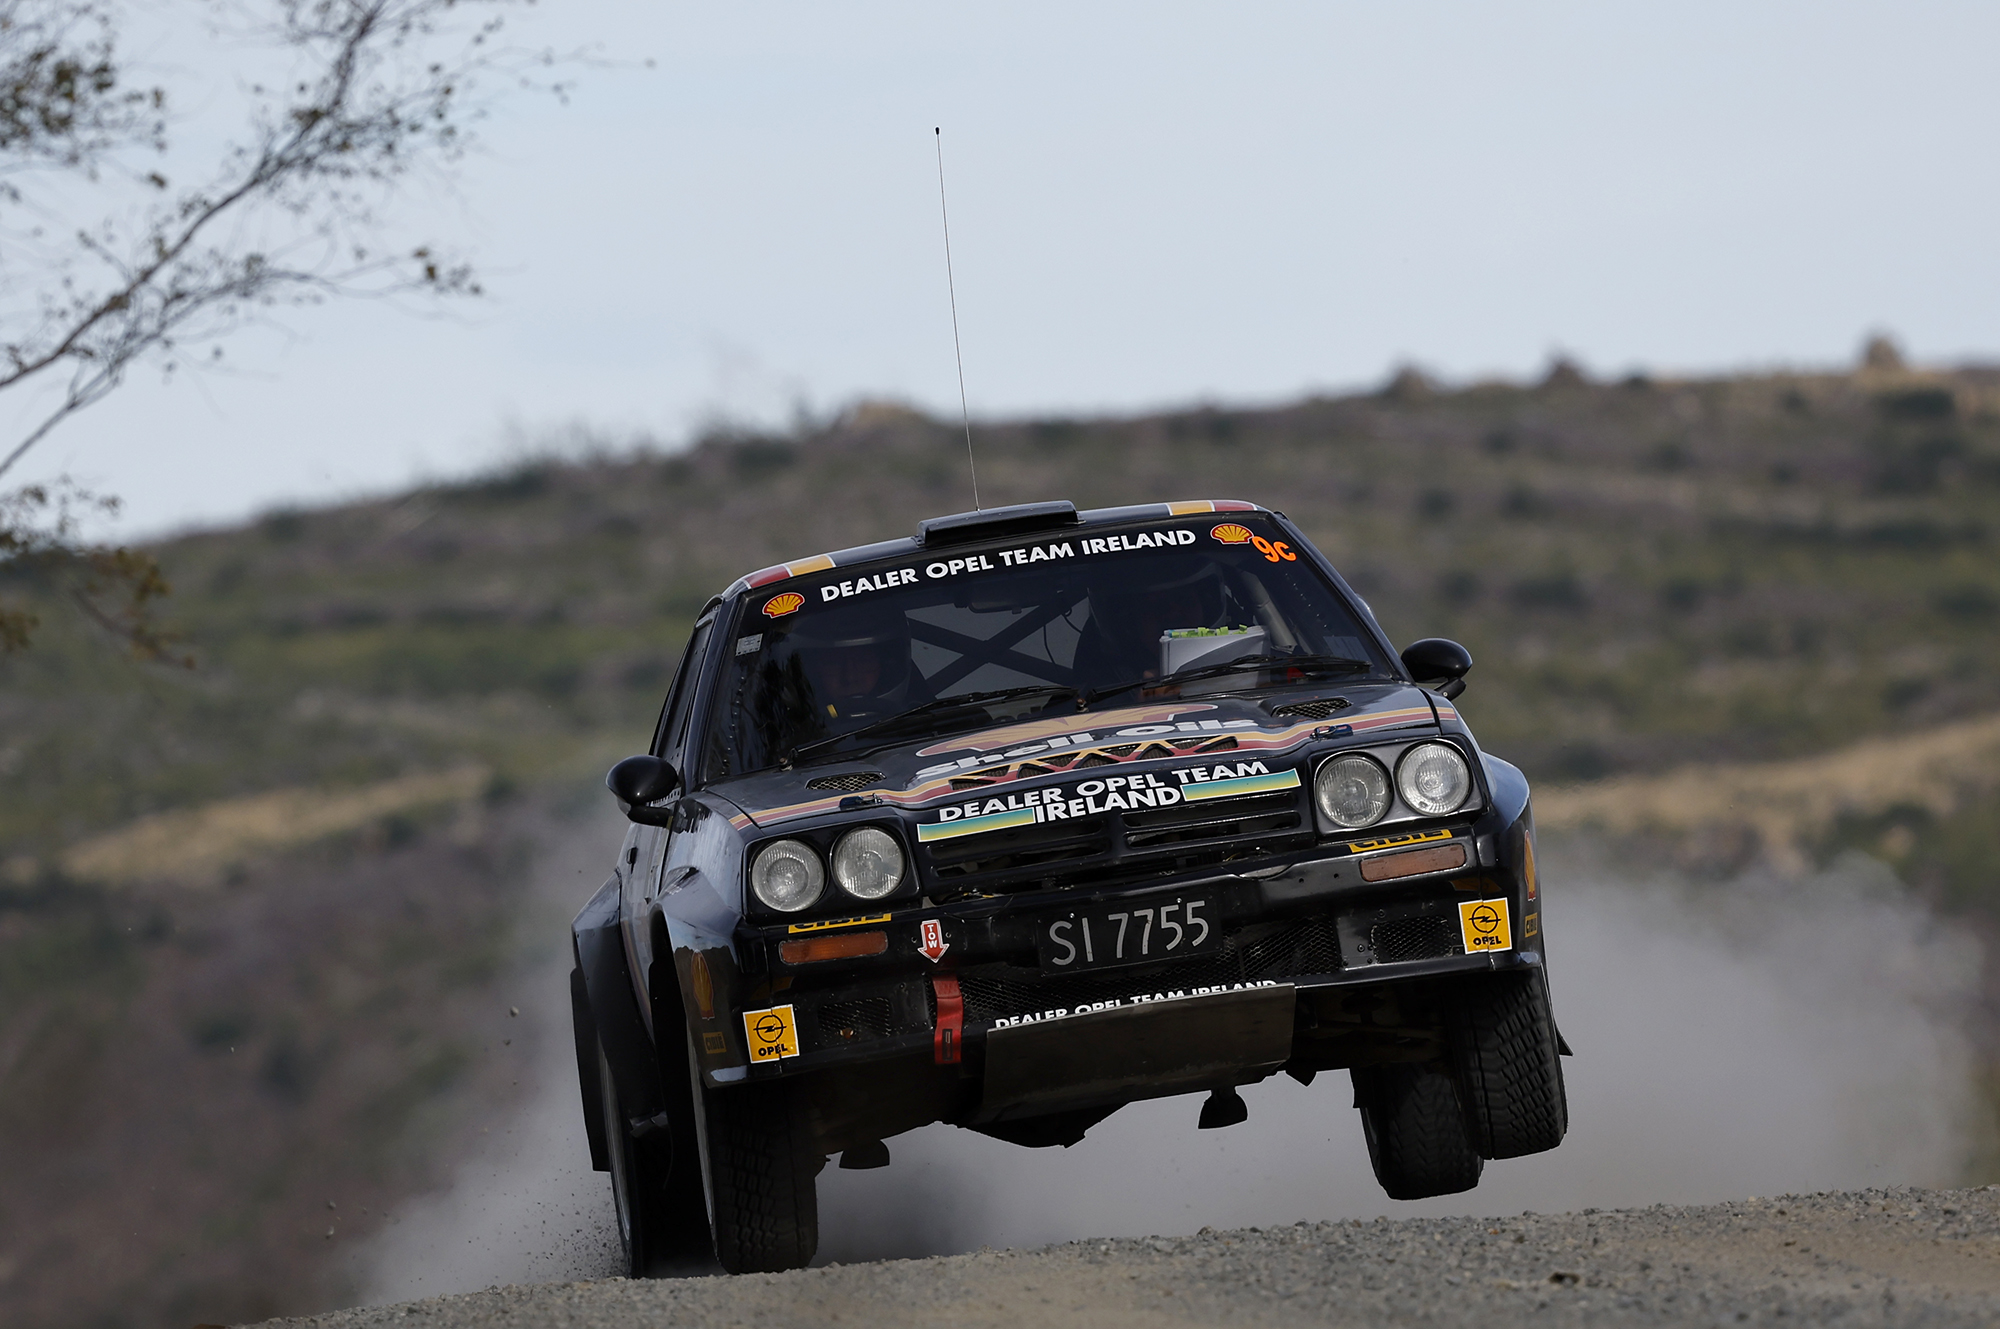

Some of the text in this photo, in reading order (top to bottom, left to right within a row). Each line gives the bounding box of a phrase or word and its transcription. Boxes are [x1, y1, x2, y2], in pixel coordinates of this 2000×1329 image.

[820, 530, 1196, 602] DEALER OPEL TEAM IRELAND
[939, 761, 1270, 822] DEALER OPEL TEAM
[1035, 786, 1182, 824] IRELAND
[927, 924, 938, 949] TOW
[1108, 900, 1209, 959] 7755
[1473, 935, 1502, 946] OPEL
[995, 1008, 1068, 1029] DEALER
[758, 1043, 788, 1057] OPEL
